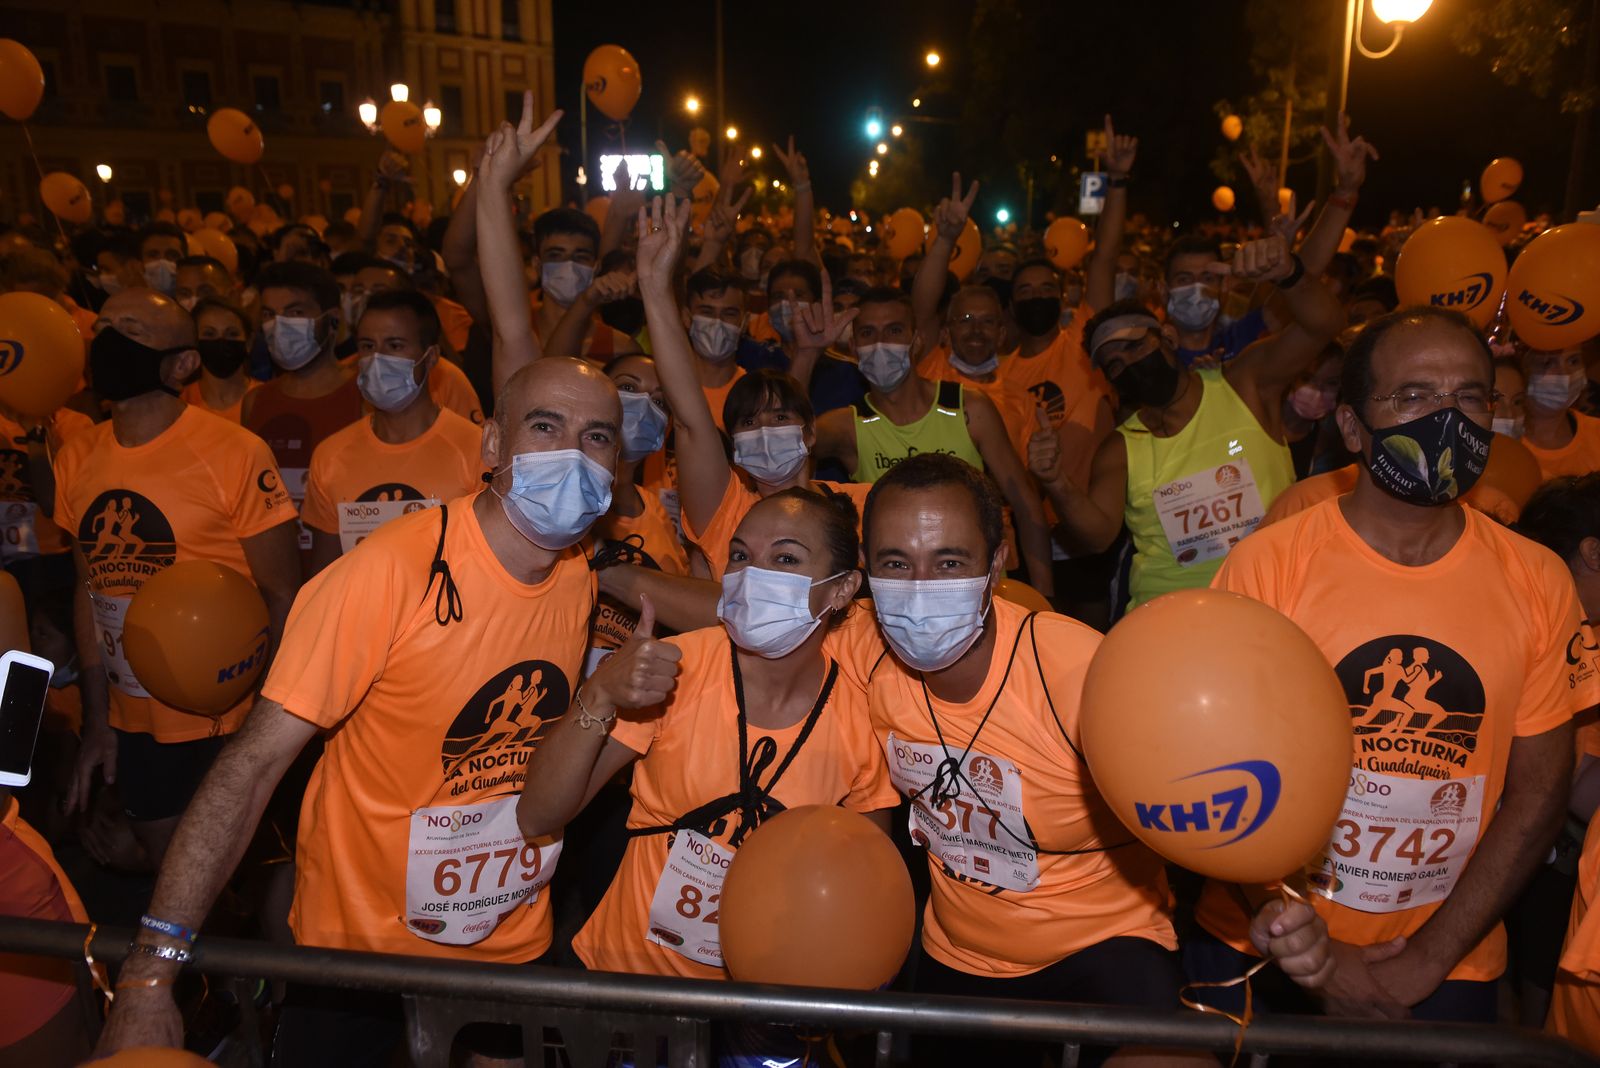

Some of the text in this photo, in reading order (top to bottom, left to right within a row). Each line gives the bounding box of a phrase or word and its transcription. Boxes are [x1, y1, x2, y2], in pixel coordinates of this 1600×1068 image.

[1174, 493, 1243, 534] 7267
[1361, 737, 1468, 768] NOCTURNA
[912, 806, 940, 836] FRANCISCO
[966, 838, 1008, 855] MARTÍNEZ
[1332, 819, 1456, 866] 3742
[434, 847, 460, 856] CARRERA
[461, 842, 492, 852] NOCTURNA
[433, 842, 542, 897] 6779
[1372, 869, 1417, 882] ROMERO
[421, 901, 450, 912] JOSÉ
[452, 893, 510, 912] RODRÍGUEZ
